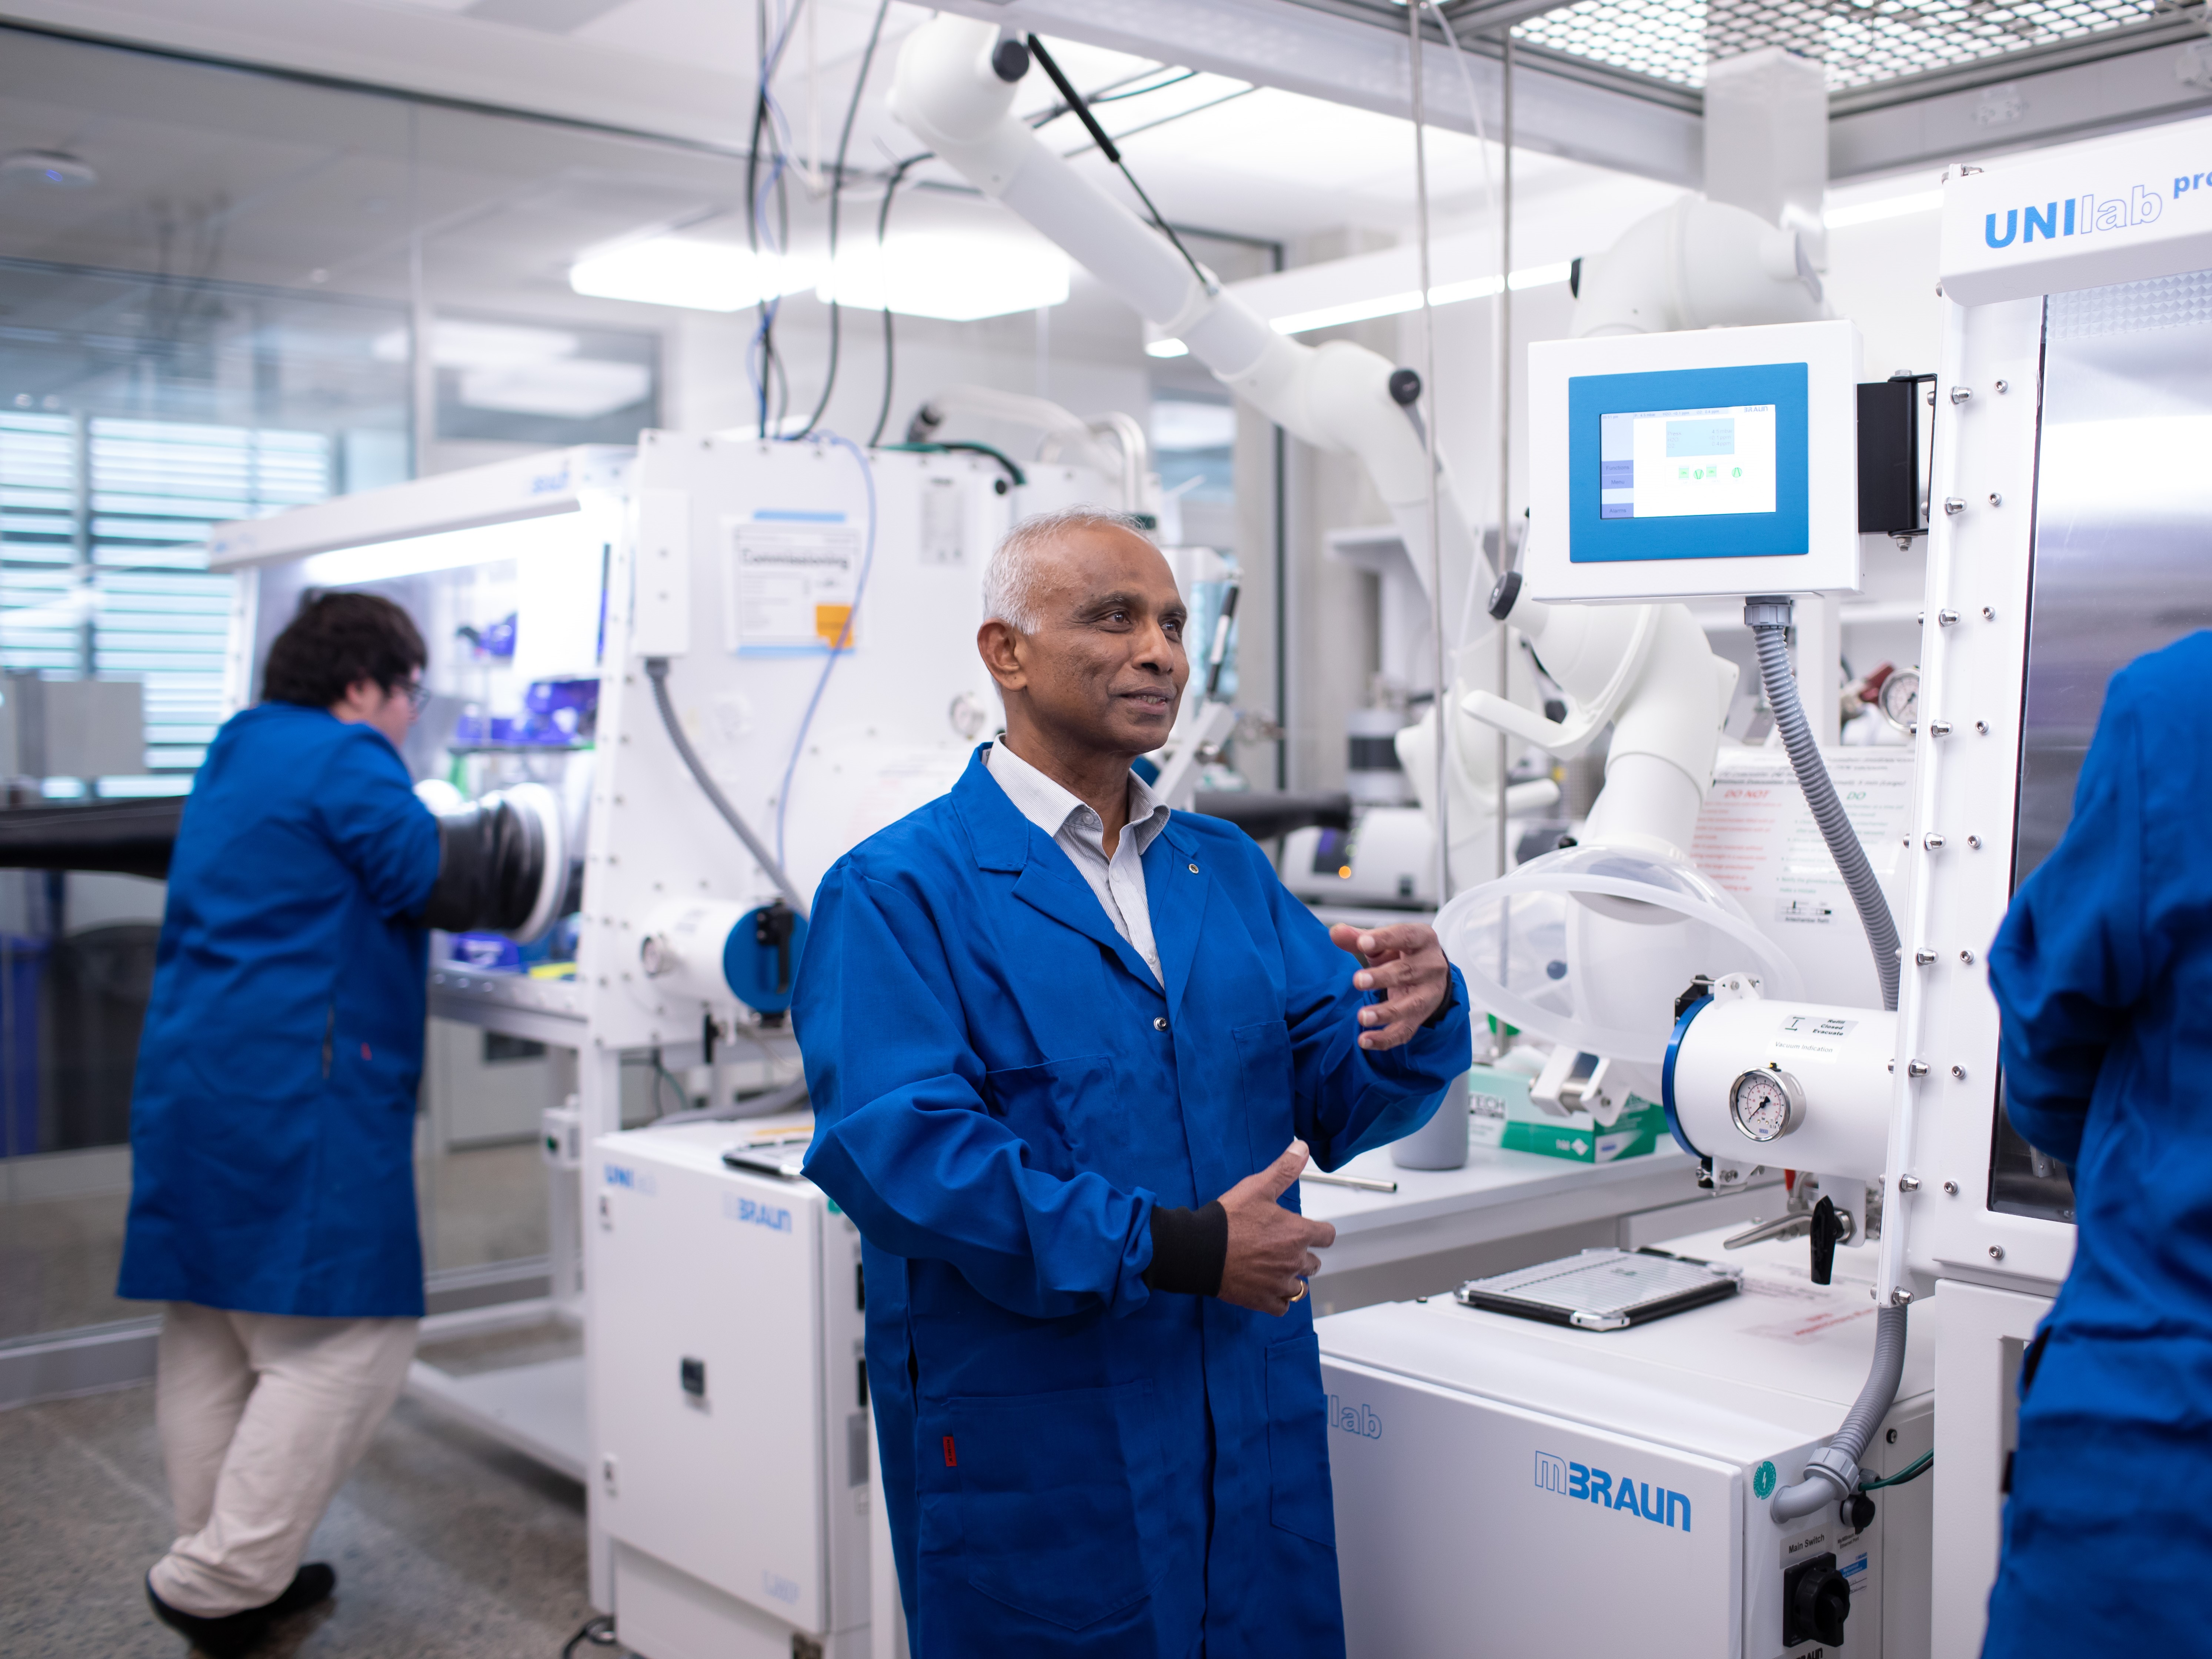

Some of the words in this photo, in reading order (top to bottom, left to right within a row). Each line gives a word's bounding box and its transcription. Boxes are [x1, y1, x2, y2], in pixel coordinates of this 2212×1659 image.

[1985, 185, 2162, 248] UNIlab
[1846, 791, 1866, 800] DO
[1802, 1045, 1833, 1053] Indication
[1789, 1542, 1803, 1553] Main
[1805, 1533, 1825, 1548] Switch
